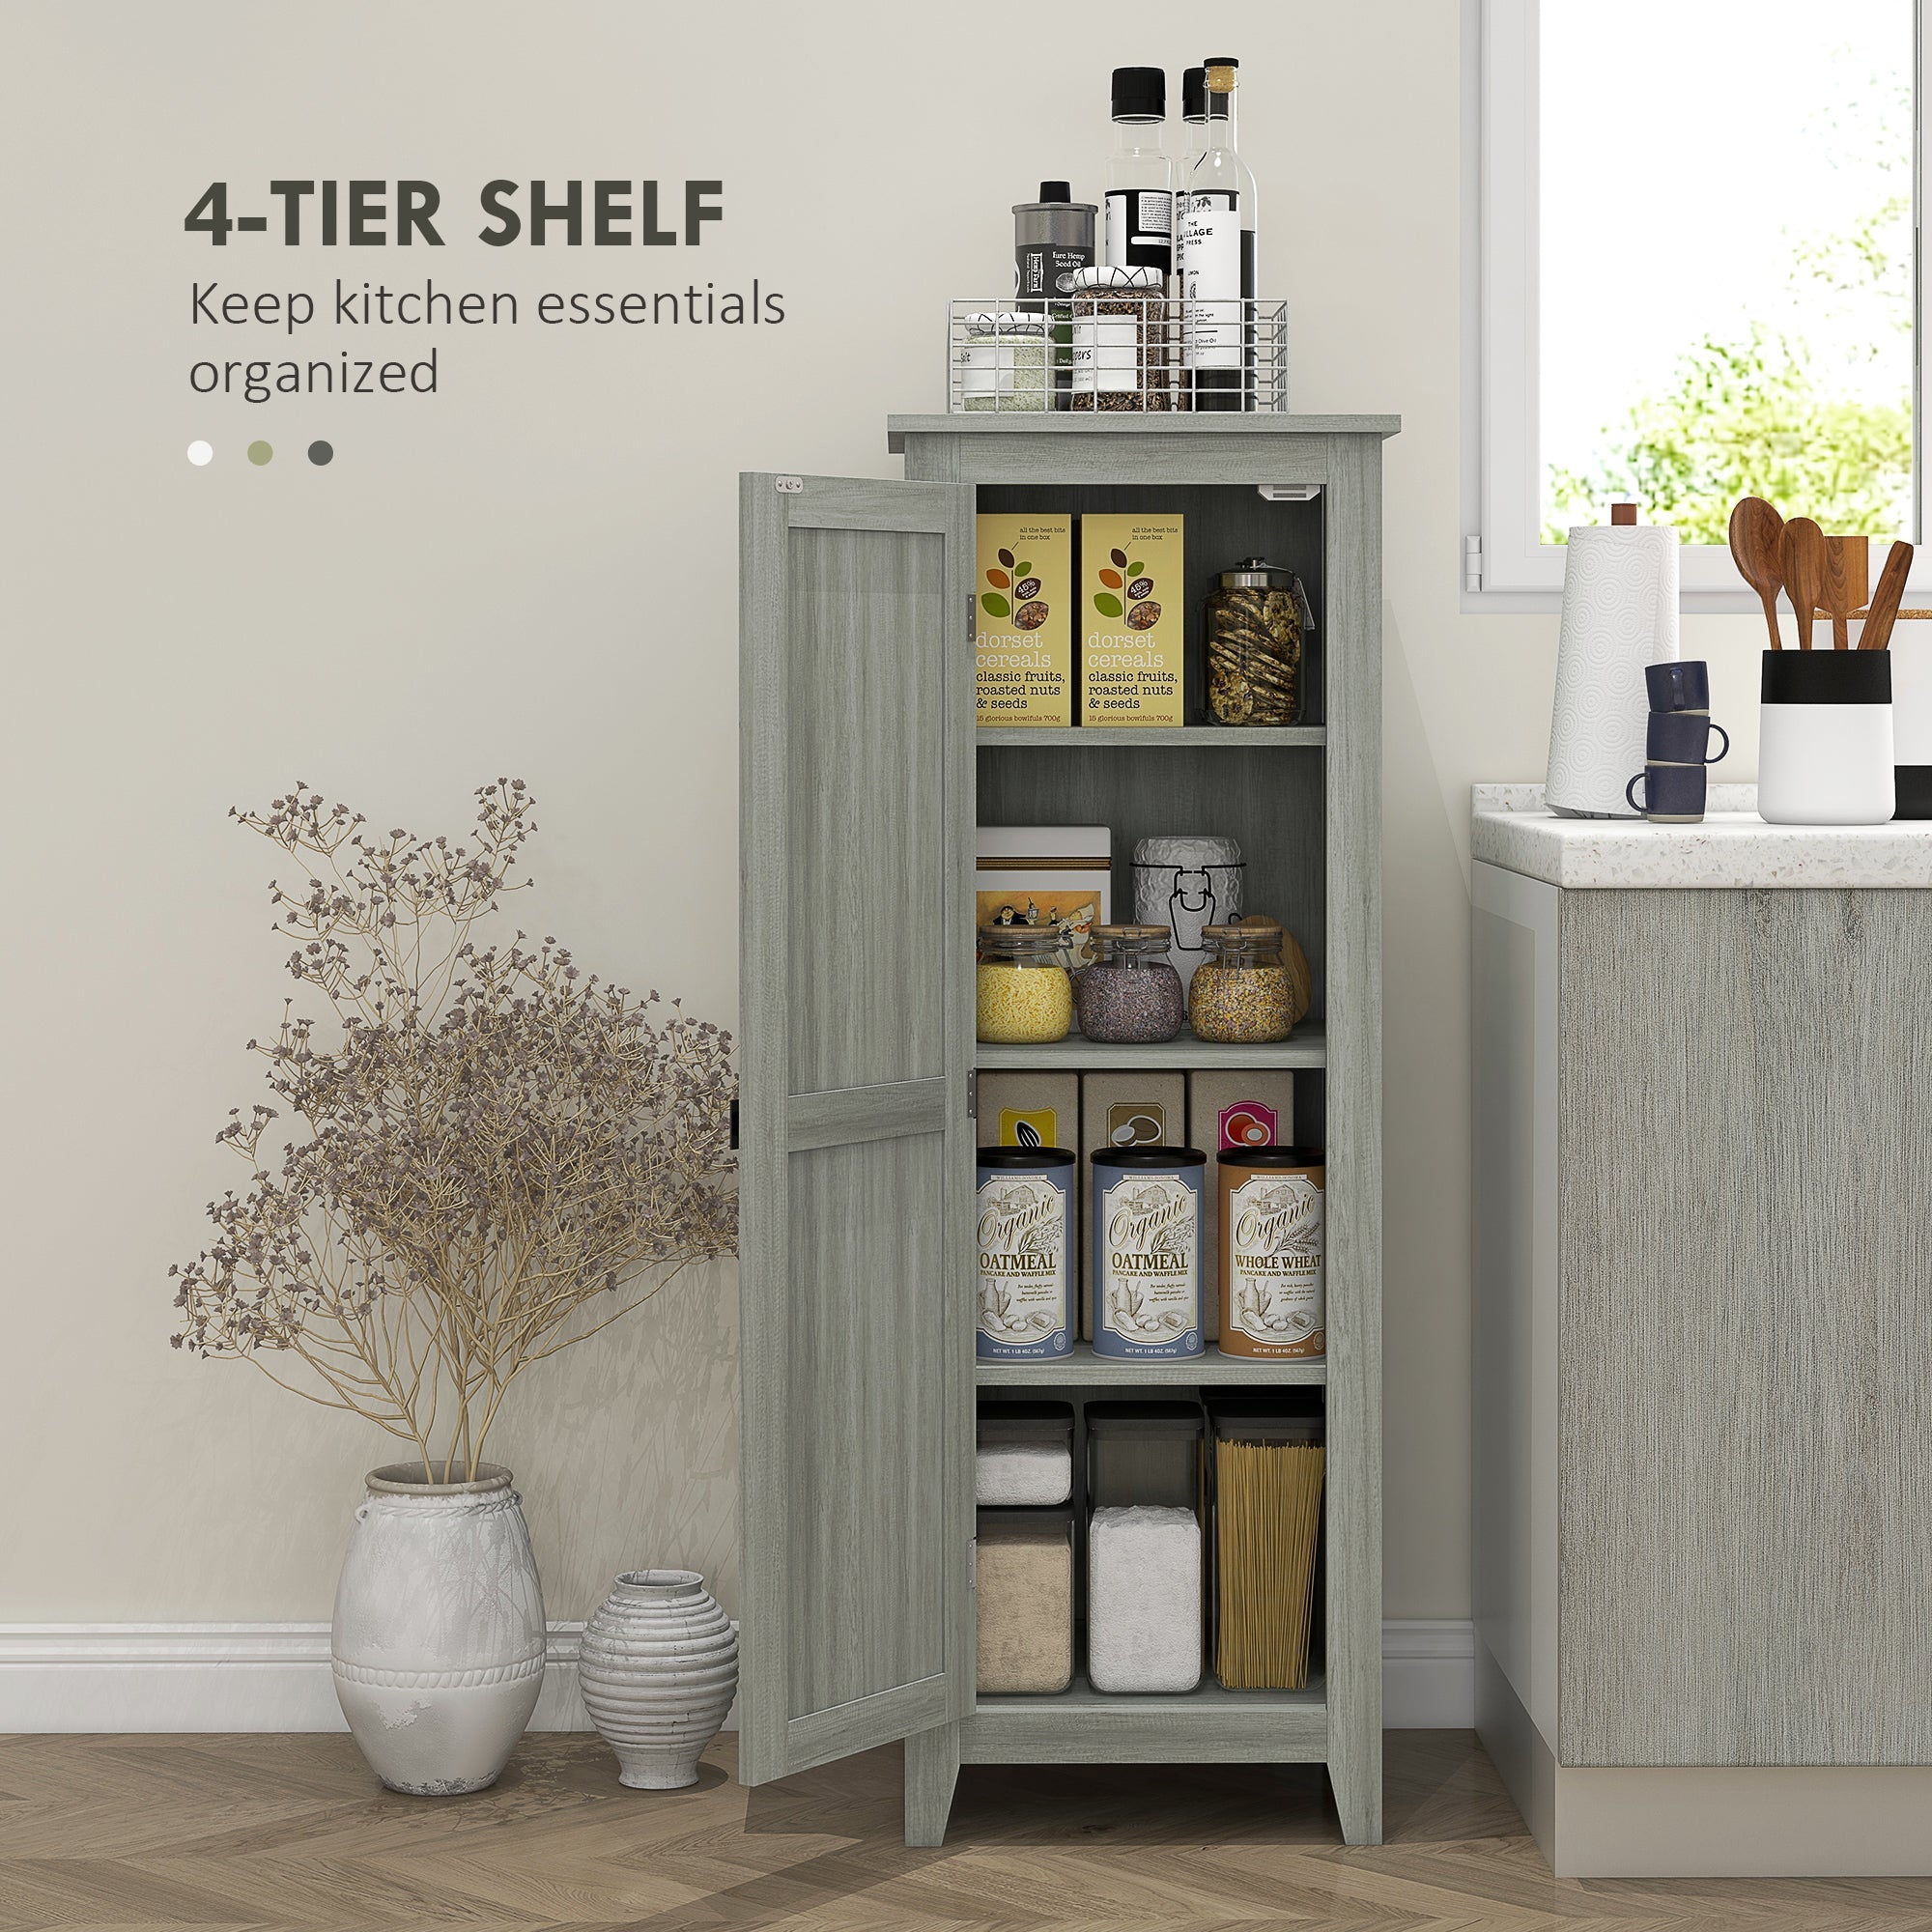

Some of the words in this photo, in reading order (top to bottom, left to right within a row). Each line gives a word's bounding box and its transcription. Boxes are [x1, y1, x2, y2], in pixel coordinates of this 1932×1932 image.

[976, 632, 1043, 648] dorset
[1088, 632, 1155, 648] dorset
[976, 651, 1051, 668] cereals
[1088, 651, 1164, 668] cereals
[976, 671, 1021, 682] classic
[1025, 671, 1065, 683] fruits,
[1089, 671, 1134, 682] classic
[1137, 671, 1178, 683] fruits,
[976, 685, 1026, 695] roasted
[1030, 686, 1061, 695] nuts
[1089, 685, 1139, 695] roasted
[1143, 686, 1173, 695] nuts
[976, 698, 987, 708] &
[991, 698, 1028, 708] seeds
[1089, 698, 1100, 708] &
[1103, 698, 1140, 708] seeds
[978, 1194, 1055, 1252] Organic
[1109, 1194, 1188, 1252] Organic
[1236, 1194, 1314, 1251] Organic
[980, 1252, 1056, 1269] OATMEAL
[1113, 1252, 1188, 1269] OATMEAL
[1236, 1255, 1279, 1268] WHOLE
[1281, 1255, 1321, 1268] WHEAT
